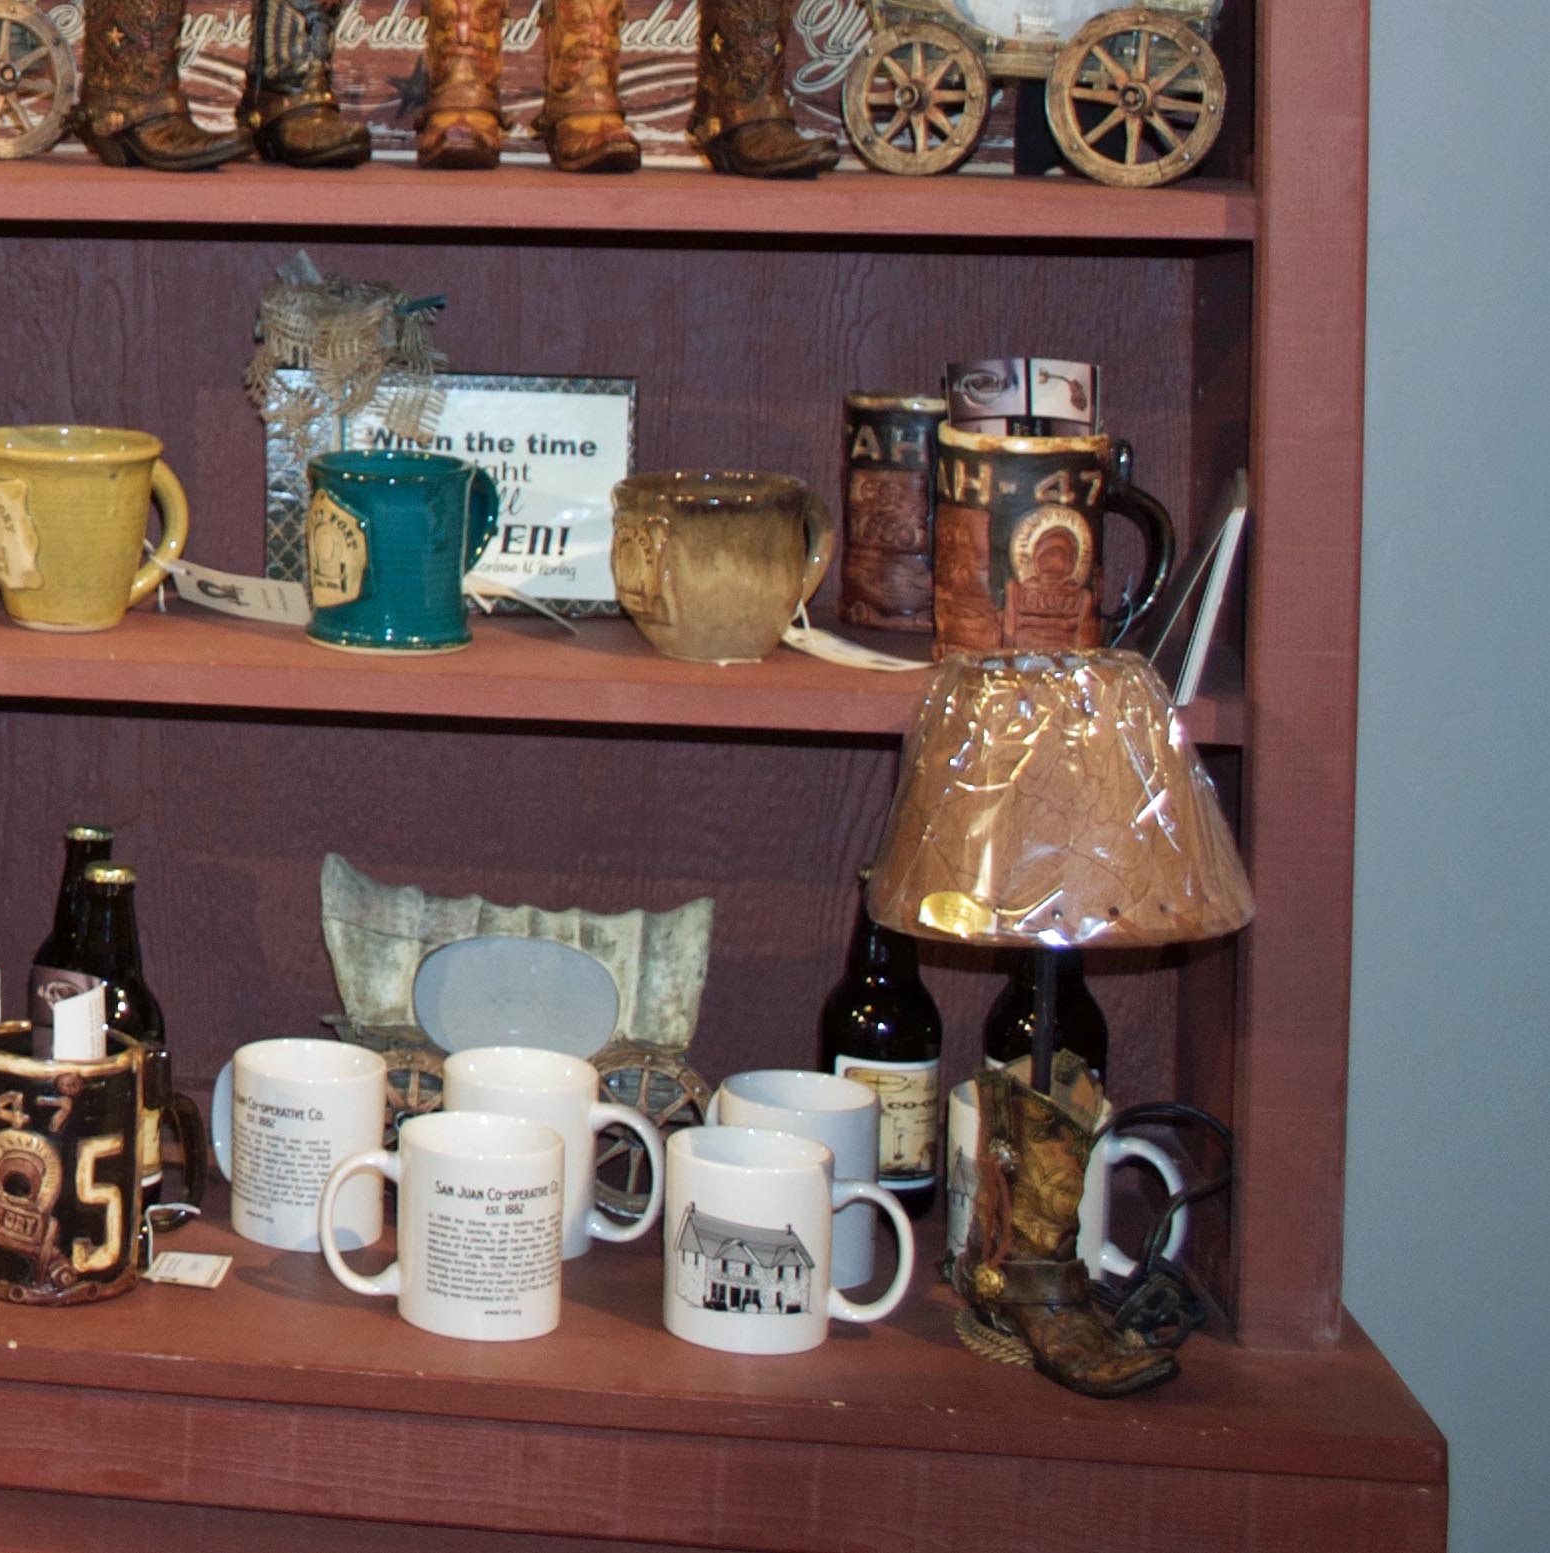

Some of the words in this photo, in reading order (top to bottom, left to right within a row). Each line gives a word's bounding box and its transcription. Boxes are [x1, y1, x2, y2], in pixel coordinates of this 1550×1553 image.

[372, 426, 452, 451] Whn
[464, 430, 516, 454] the
[526, 432, 598, 457] time
[71, 1132, 124, 1273] 5
